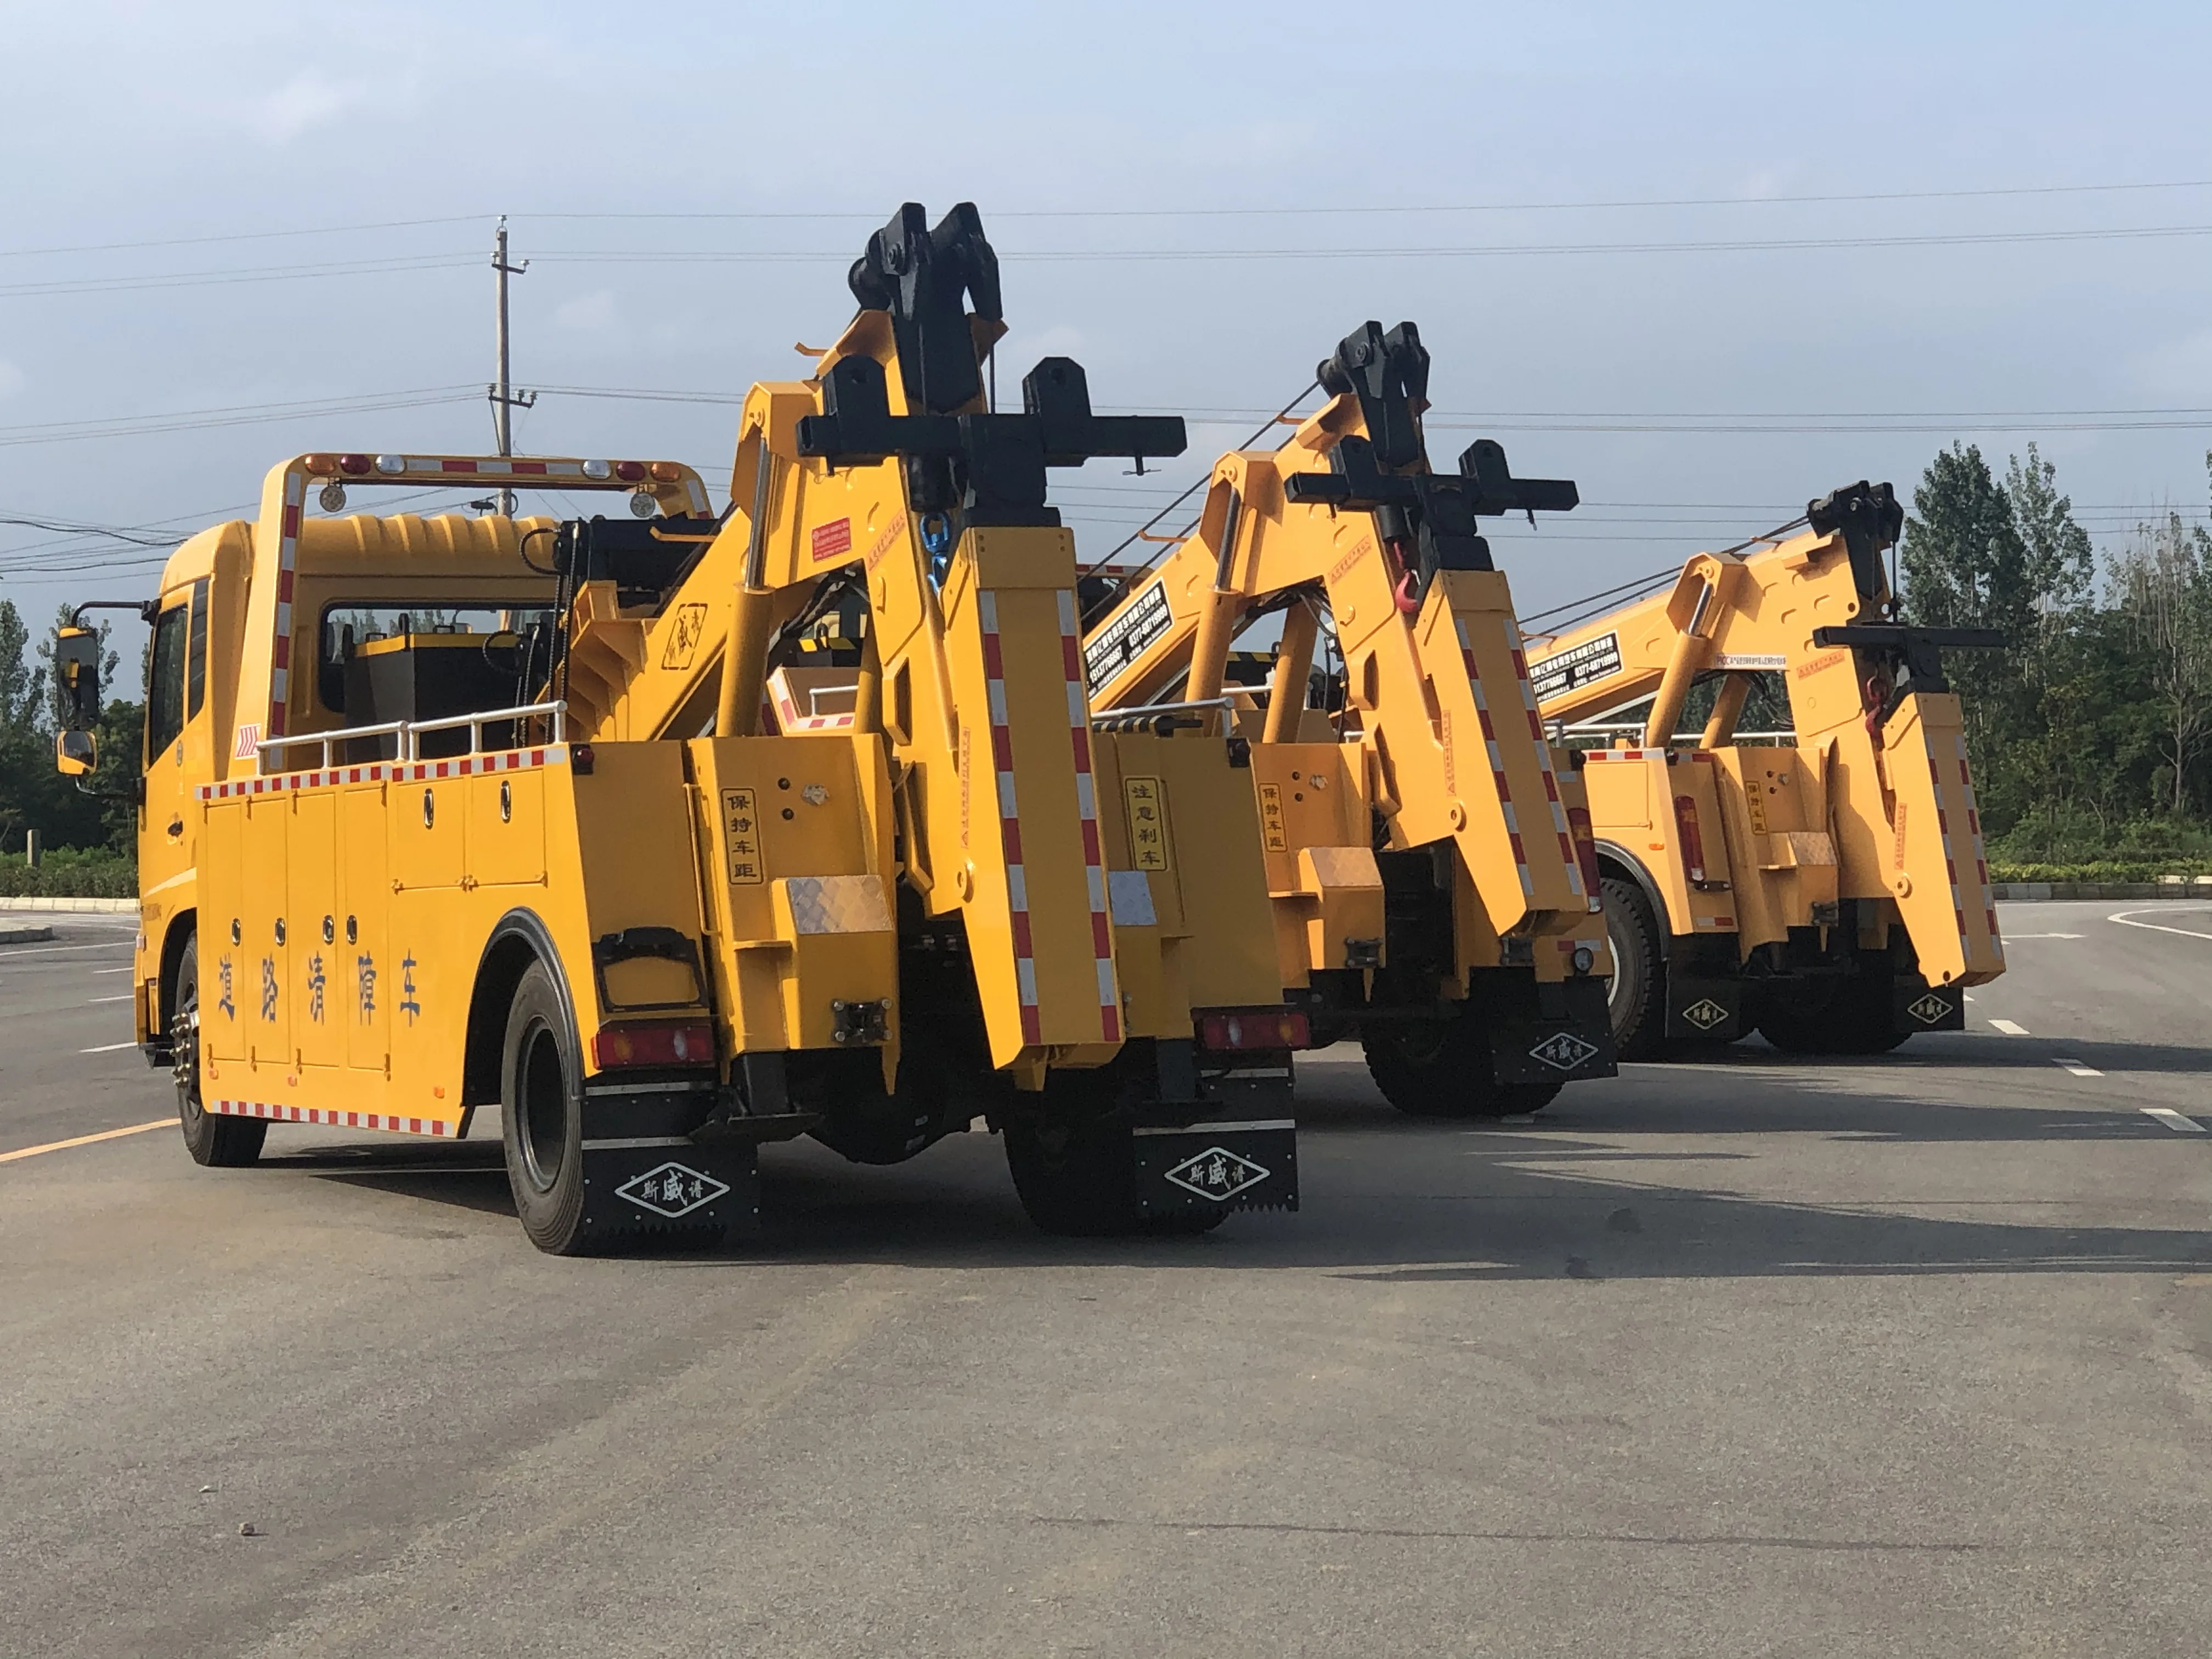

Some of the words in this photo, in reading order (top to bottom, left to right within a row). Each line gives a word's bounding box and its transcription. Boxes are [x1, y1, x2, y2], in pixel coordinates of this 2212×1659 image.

[727, 795, 758, 878] 保持车距
[1131, 785, 1161, 865] 注意刹车
[218, 948, 420, 1027] 道路清障车
